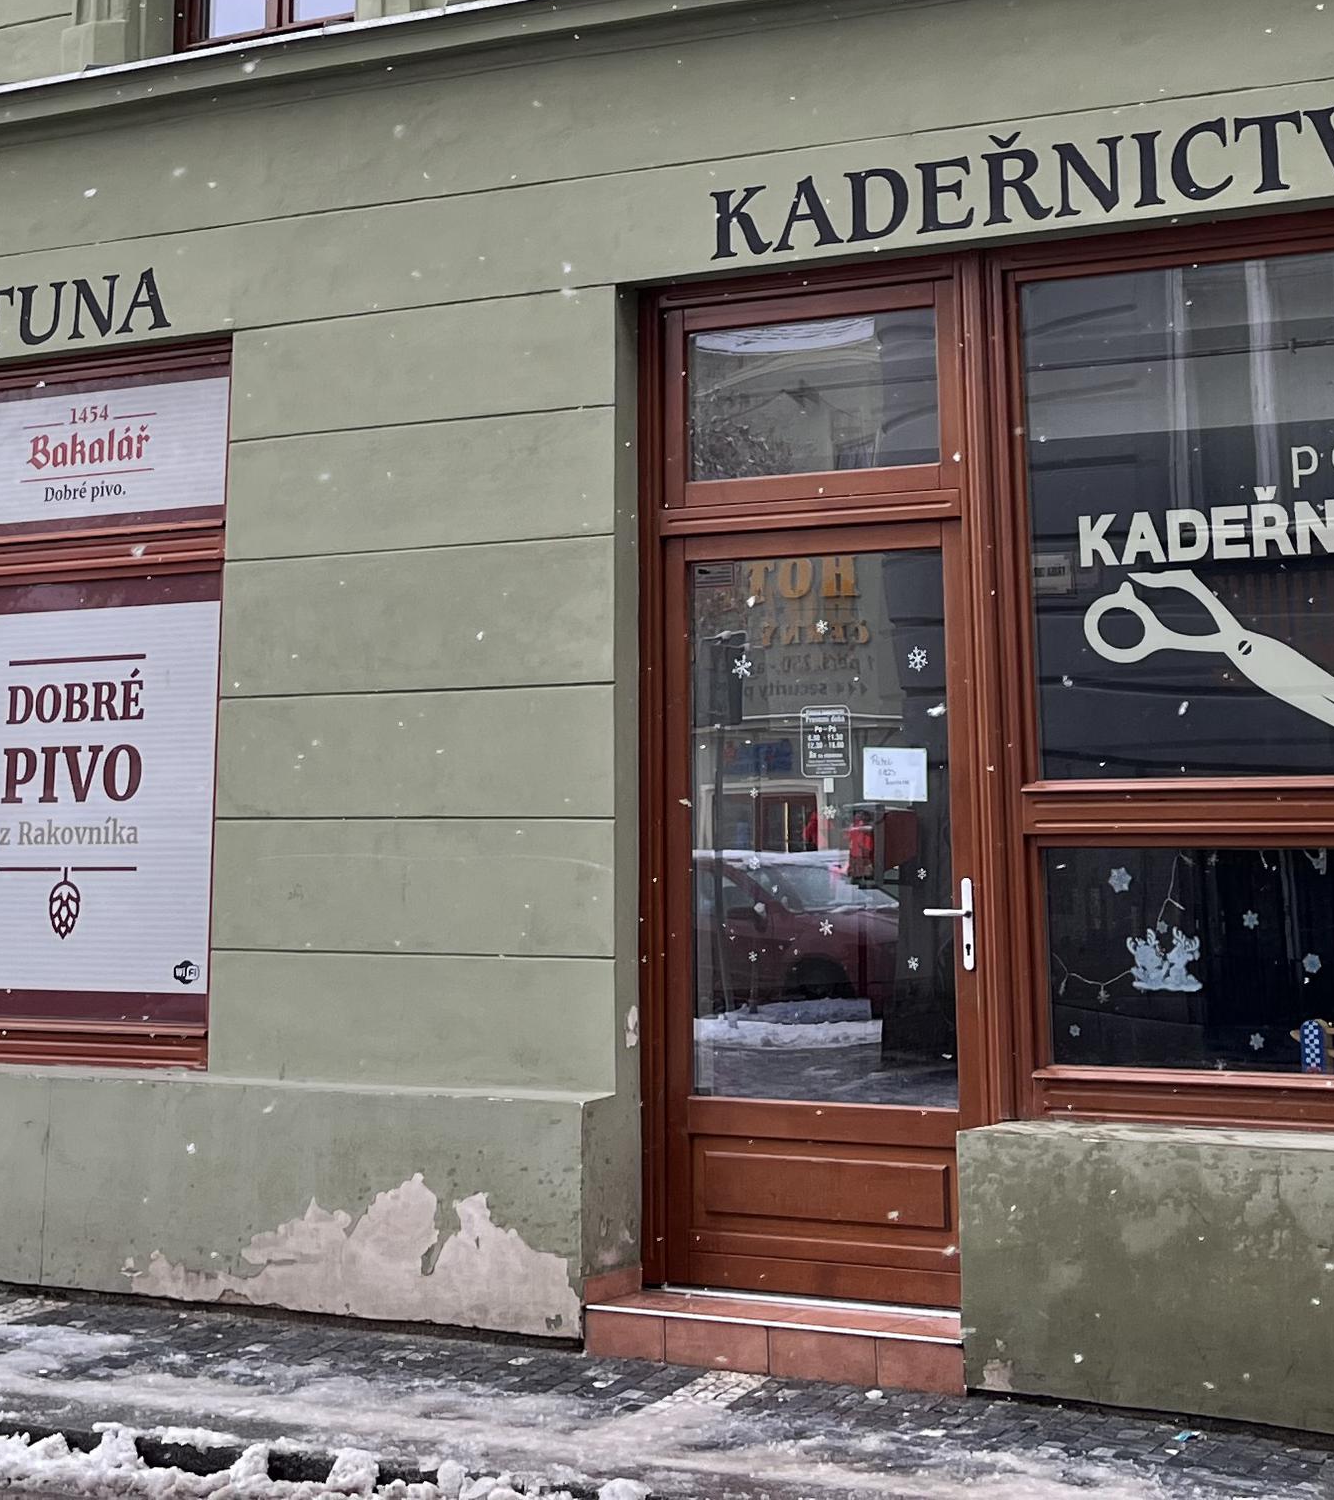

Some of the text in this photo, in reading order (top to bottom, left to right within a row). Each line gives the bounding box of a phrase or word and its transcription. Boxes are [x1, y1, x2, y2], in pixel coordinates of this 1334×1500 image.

[68, 403, 110, 425] 1454
[26, 423, 151, 470] Bakalář
[43, 479, 127, 503] Dobré pivo.
[5, 667, 146, 725] DOBRÉ
[0, 743, 143, 805] PIVO
[17, 816, 139, 846] Rakovníka
